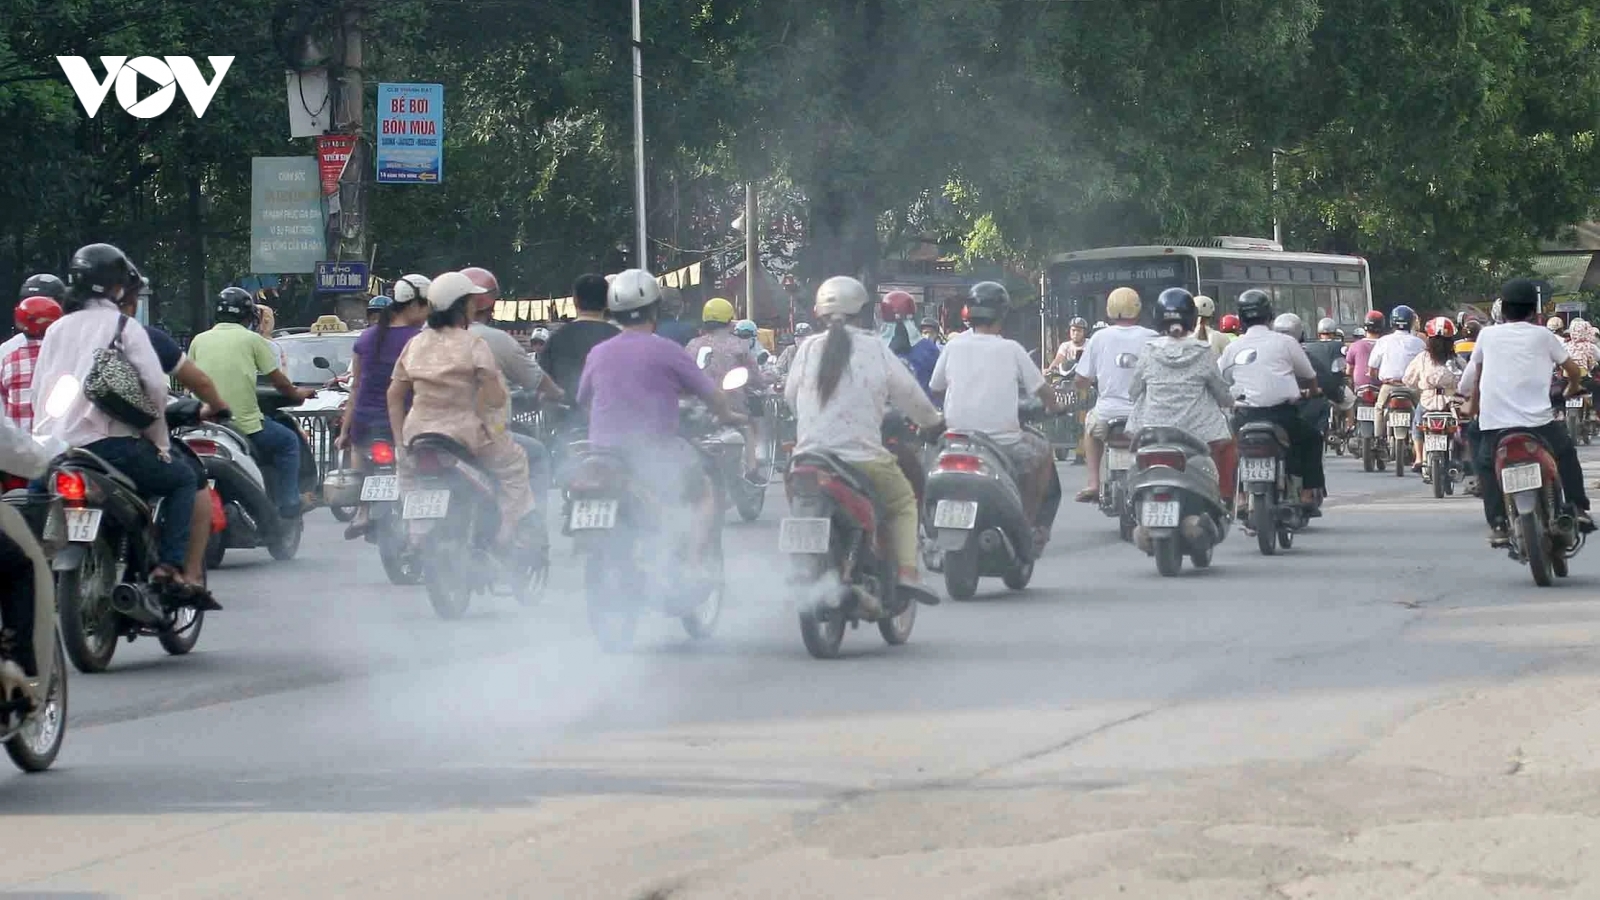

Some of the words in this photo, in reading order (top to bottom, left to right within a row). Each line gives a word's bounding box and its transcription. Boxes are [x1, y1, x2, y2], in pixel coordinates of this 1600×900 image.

[409, 98, 428, 113] BƠI
[382, 115, 406, 134] BỐN
[410, 118, 436, 135] MÙA
